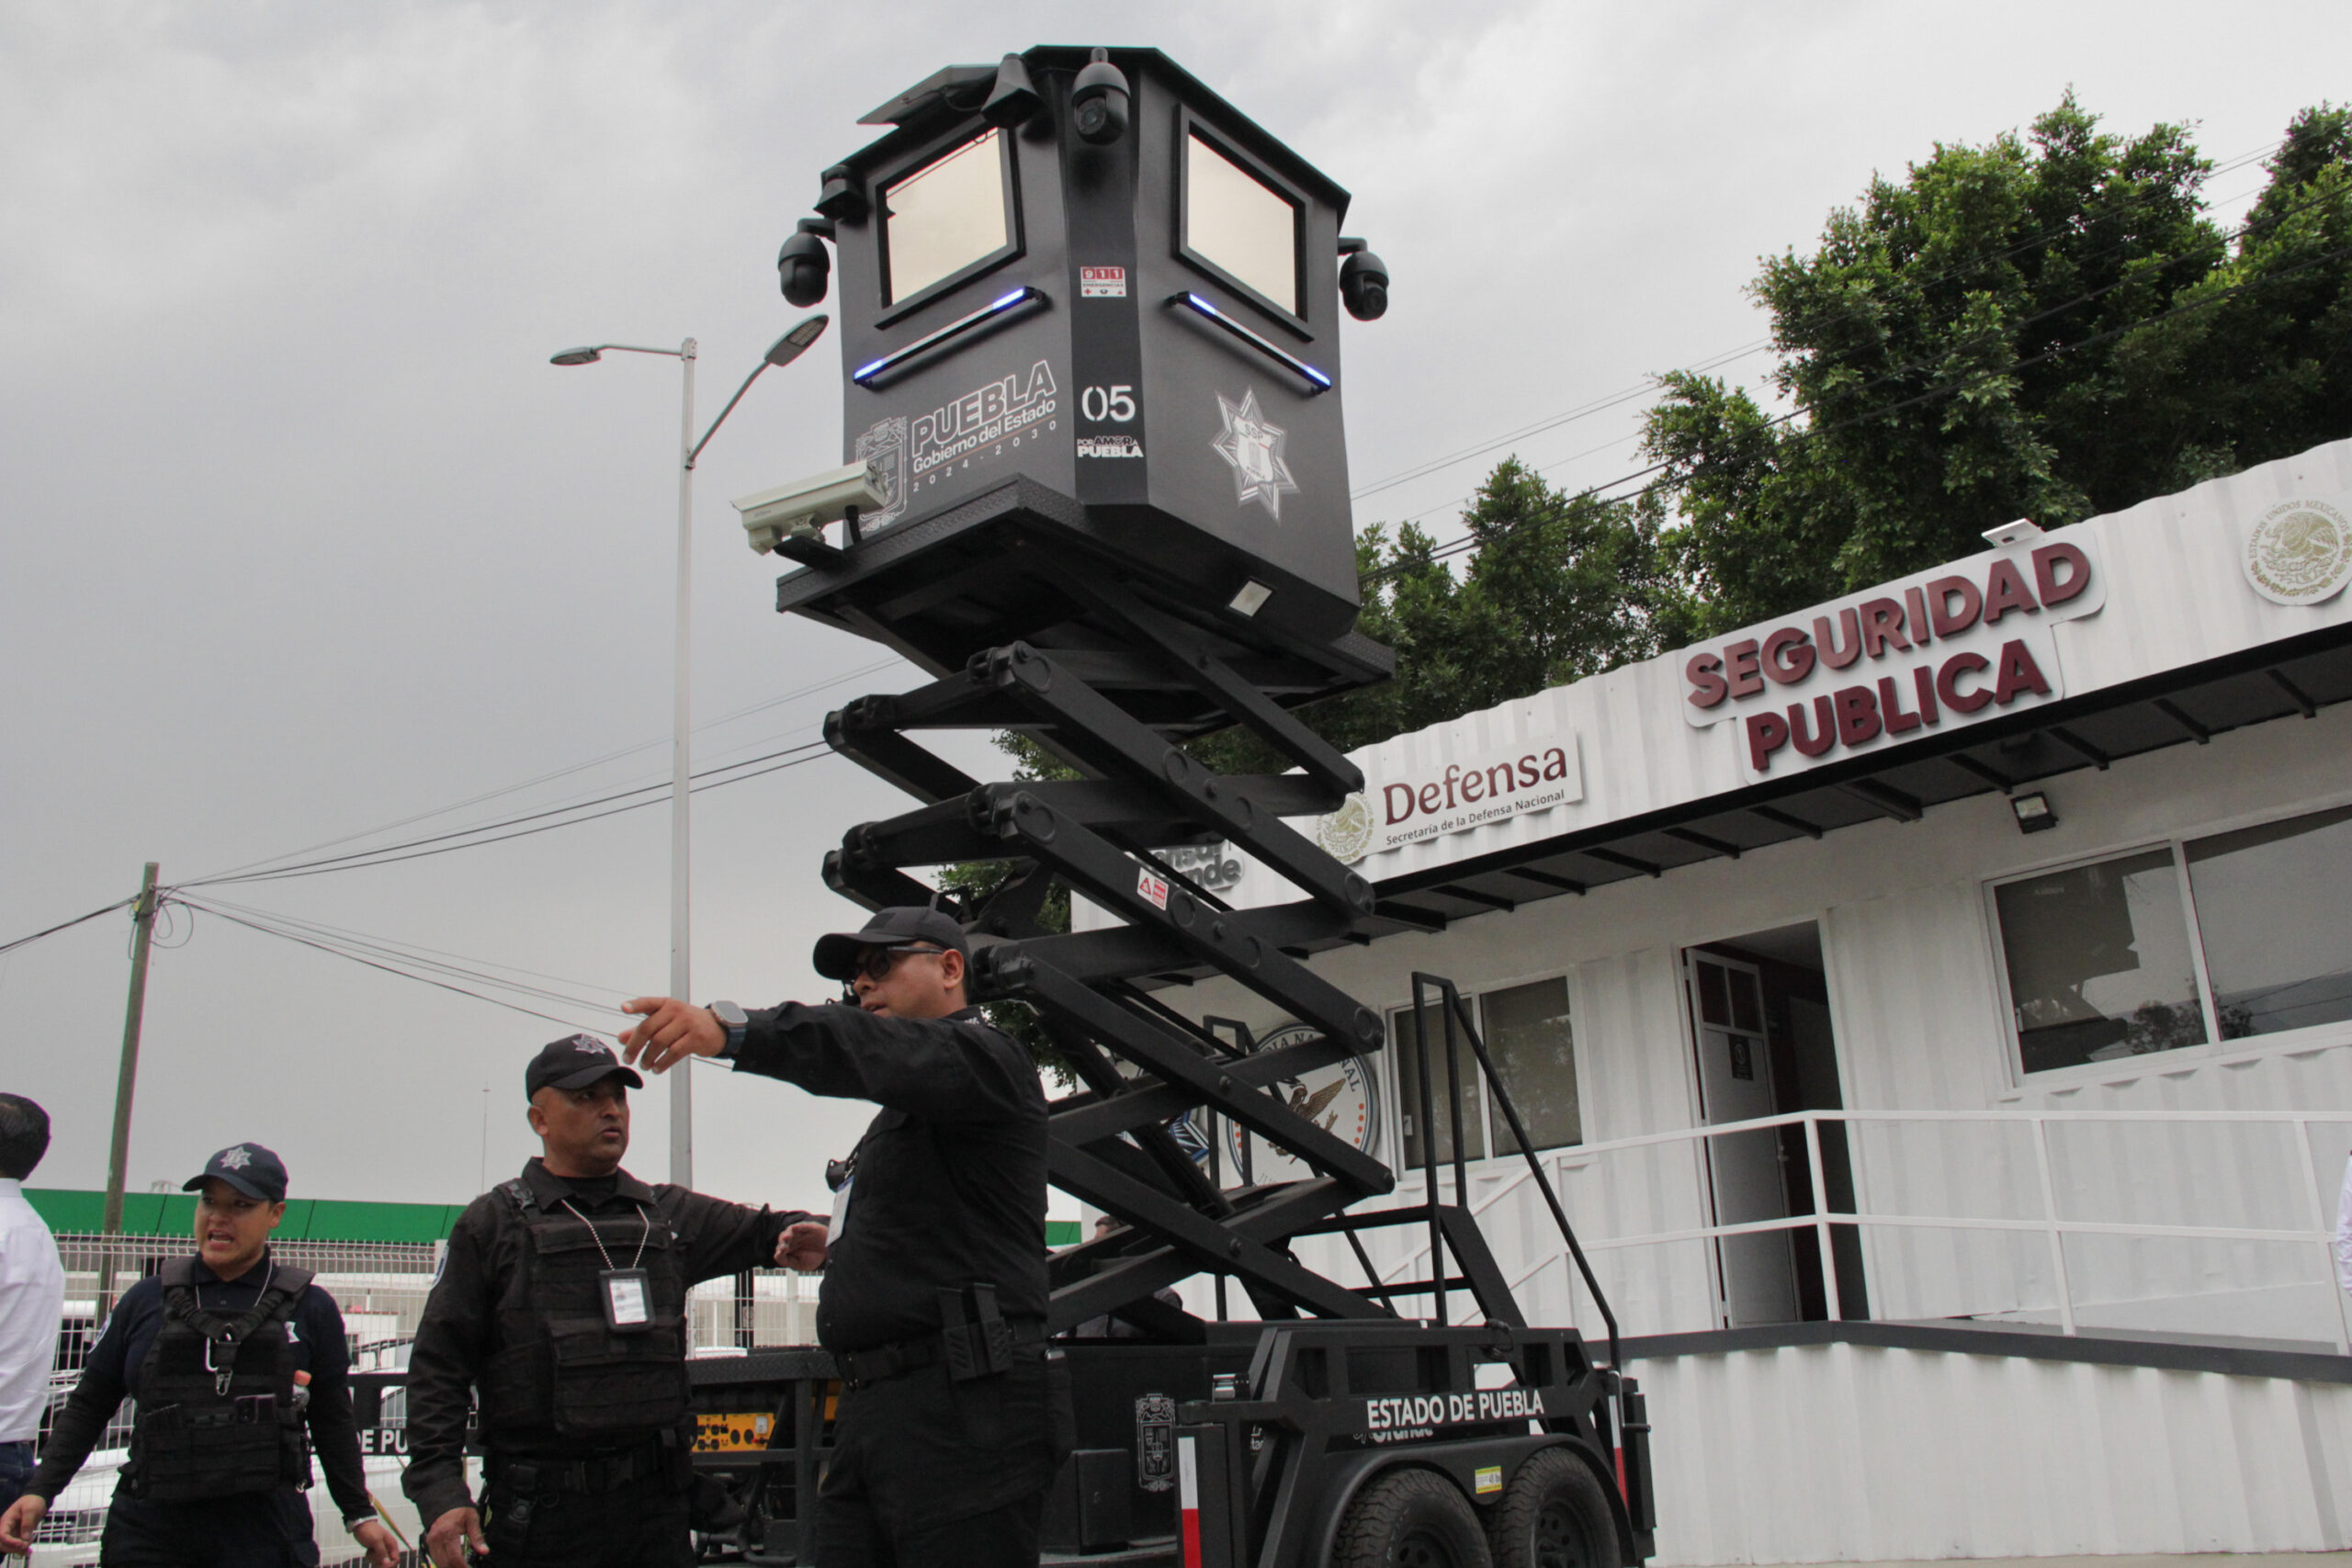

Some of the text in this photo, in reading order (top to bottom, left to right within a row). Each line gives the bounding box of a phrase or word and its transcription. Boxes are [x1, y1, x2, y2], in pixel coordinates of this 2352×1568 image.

[1084, 269, 1120, 279] 911
[912, 359, 1057, 458] PUEBLA
[1081, 385, 1136, 422] 05
[1245, 423, 1263, 440] SSP
[913, 400, 1056, 473] Gobierno del Estado
[1077, 446, 1144, 457] PUEBLA
[1685, 542, 2091, 709] SEGURIDAD
[1747, 639, 2052, 772] PUBLICA
[1383, 748, 1566, 825] Defensa
[1386, 788, 1565, 845] Secretaría de la Defensa Nacional
[1367, 1389, 1544, 1429] ESTADO DE PUEBLA
